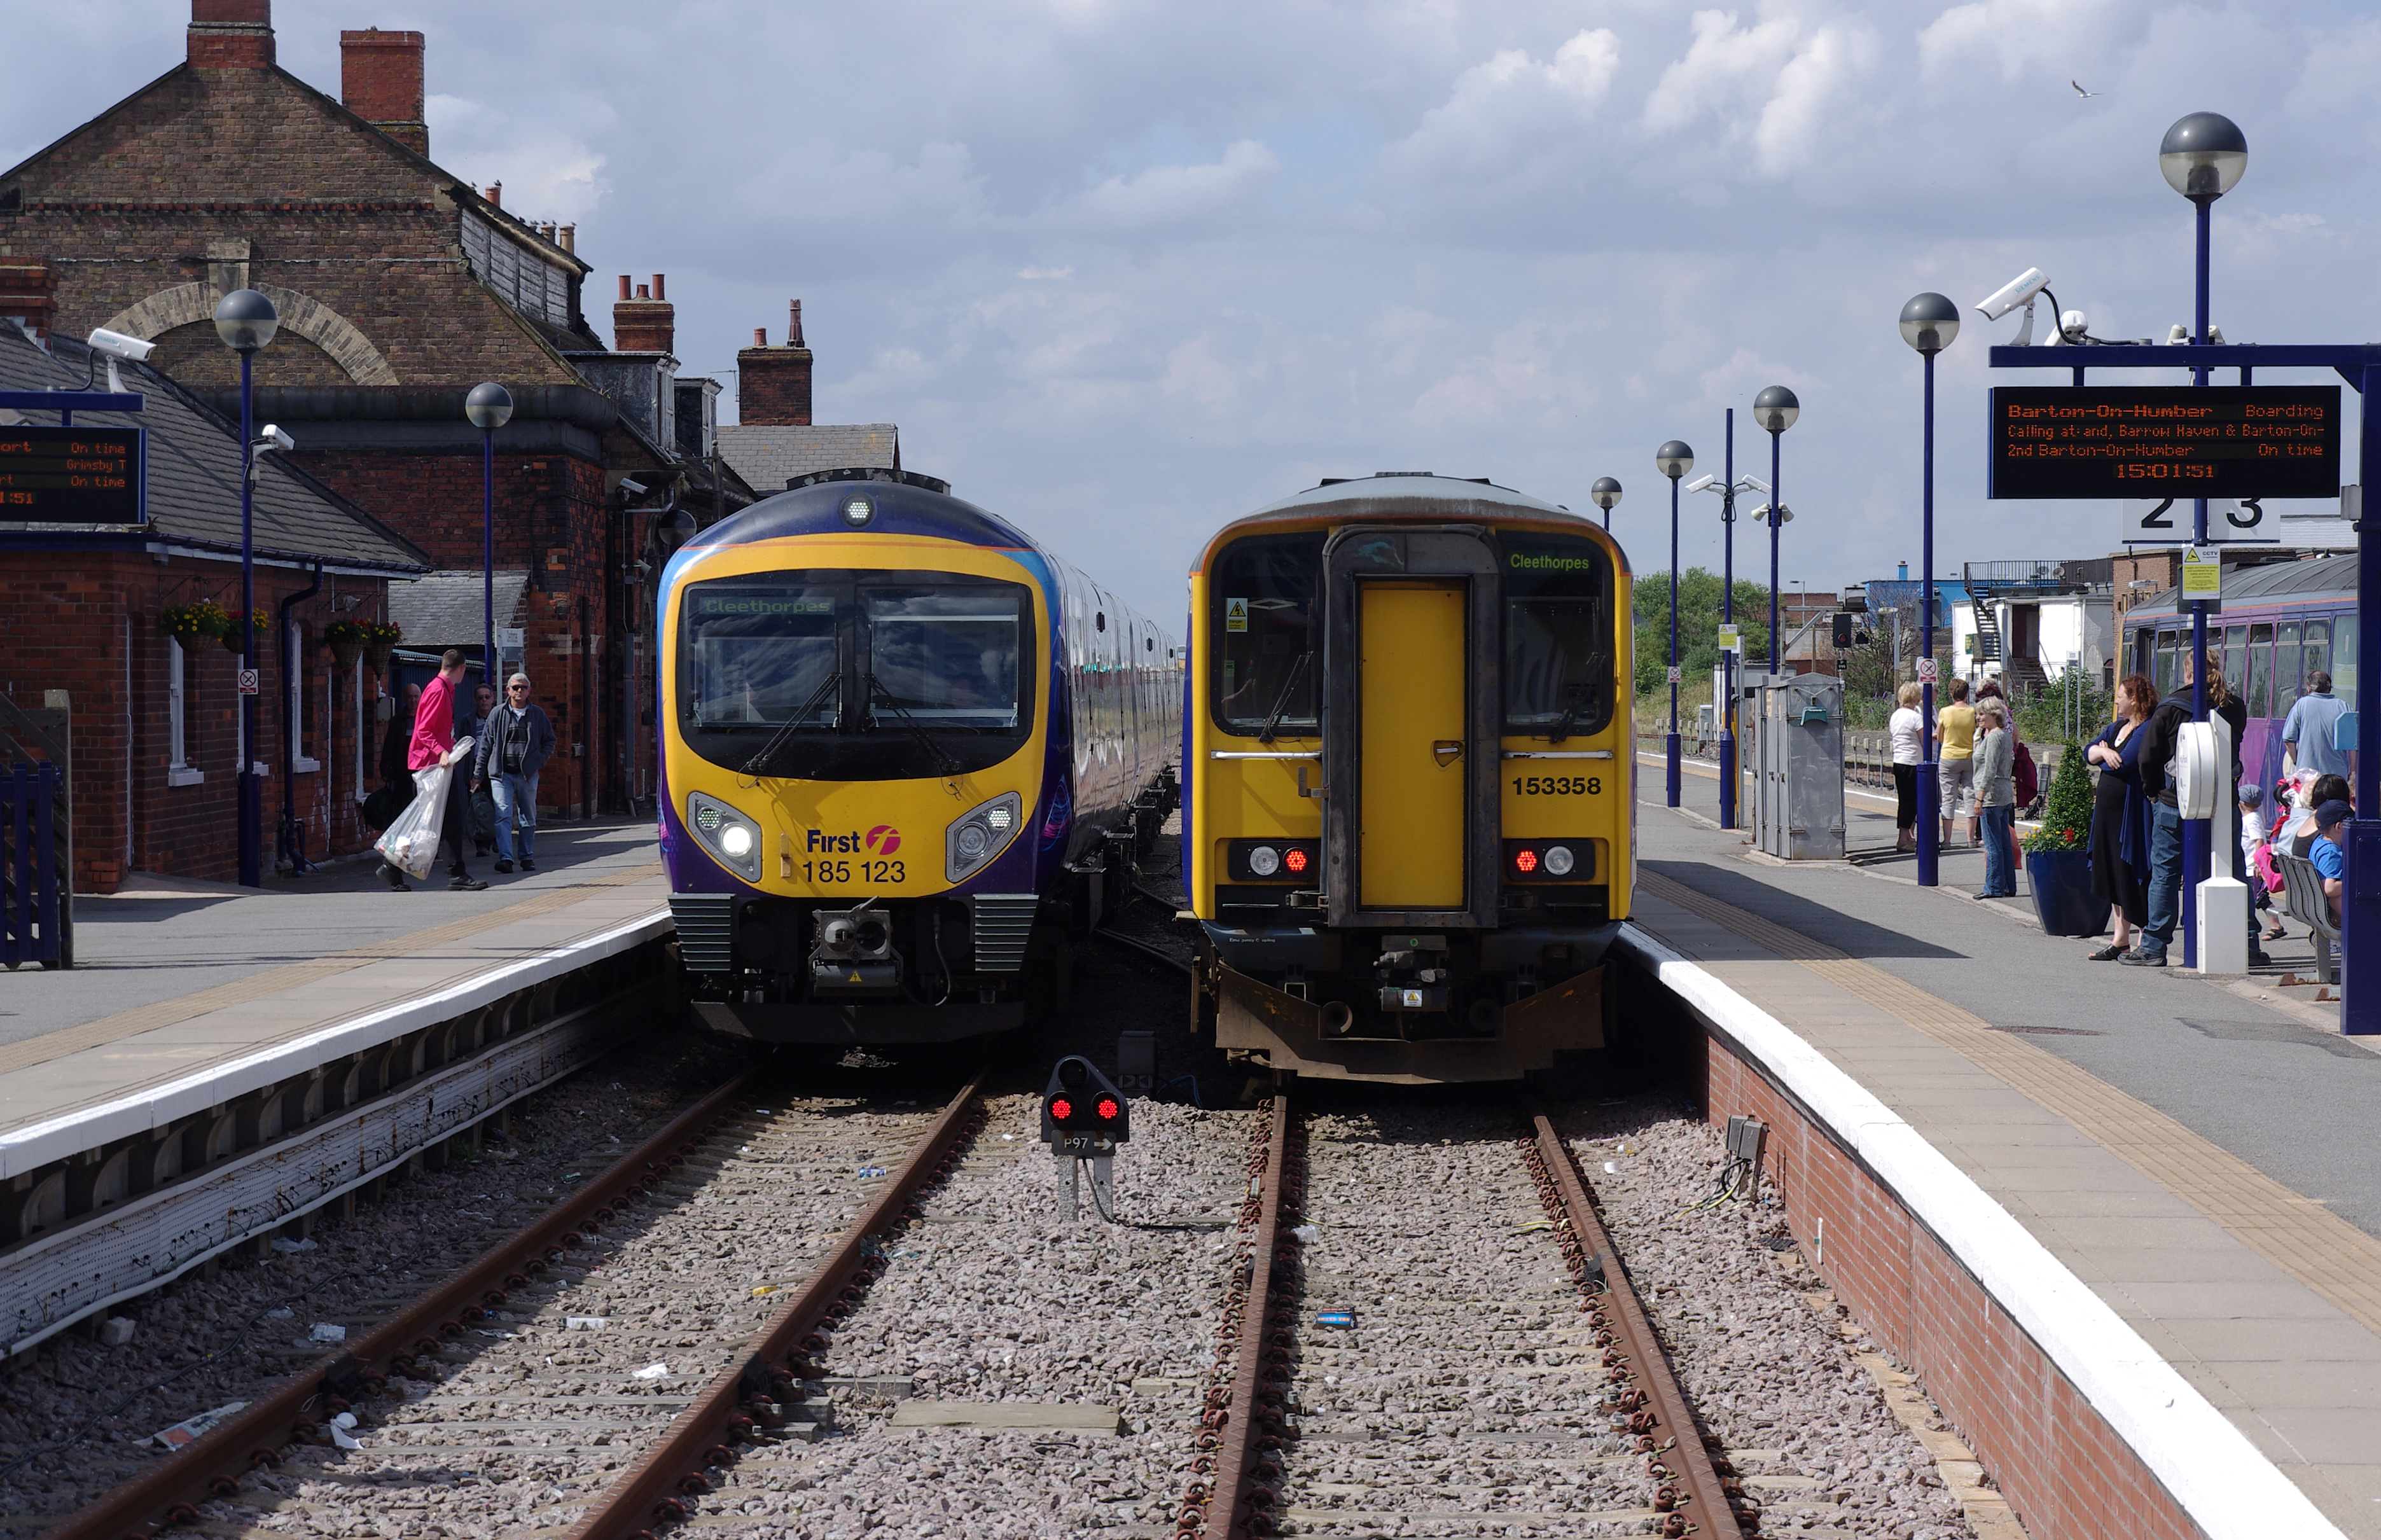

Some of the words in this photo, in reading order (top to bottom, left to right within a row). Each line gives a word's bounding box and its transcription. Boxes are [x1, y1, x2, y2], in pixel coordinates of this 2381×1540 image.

[2015, 275, 2040, 294] SIEMENS
[2008, 405, 2214, 418] Barton-On-Humber
[2245, 404, 2324, 420] Boarding
[2008, 424, 2054, 440] Calling
[2119, 424, 2170, 437] Barrow
[2177, 424, 2219, 437] Haven
[2226, 424, 2236, 437] &
[2242, 424, 2325, 437] Barton-On-
[71, 442, 88, 454] On
[95, 443, 126, 454] time
[2008, 443, 2033, 457] 2nd
[2039, 443, 2195, 457] Barton-On-Humber
[2258, 443, 2279, 456] On
[2287, 443, 2323, 456] time
[66, 459, 113, 473] Grimsby
[118, 459, 127, 471] T
[2117, 463, 2214, 478] 15:01:51
[71, 475, 88, 487] On
[95, 475, 126, 488] time
[2141, 498, 2174, 529] 2
[2226, 498, 2263, 529] 3
[1510, 553, 1590, 571] Cleethorpes
[705, 600, 830, 614] Cleethorpes
[1512, 777, 1602, 795] 153358
[807, 829, 861, 853] First
[803, 861, 850, 883] 185
[861, 861, 906, 883] 123
[1064, 1137, 1088, 1149] P97
